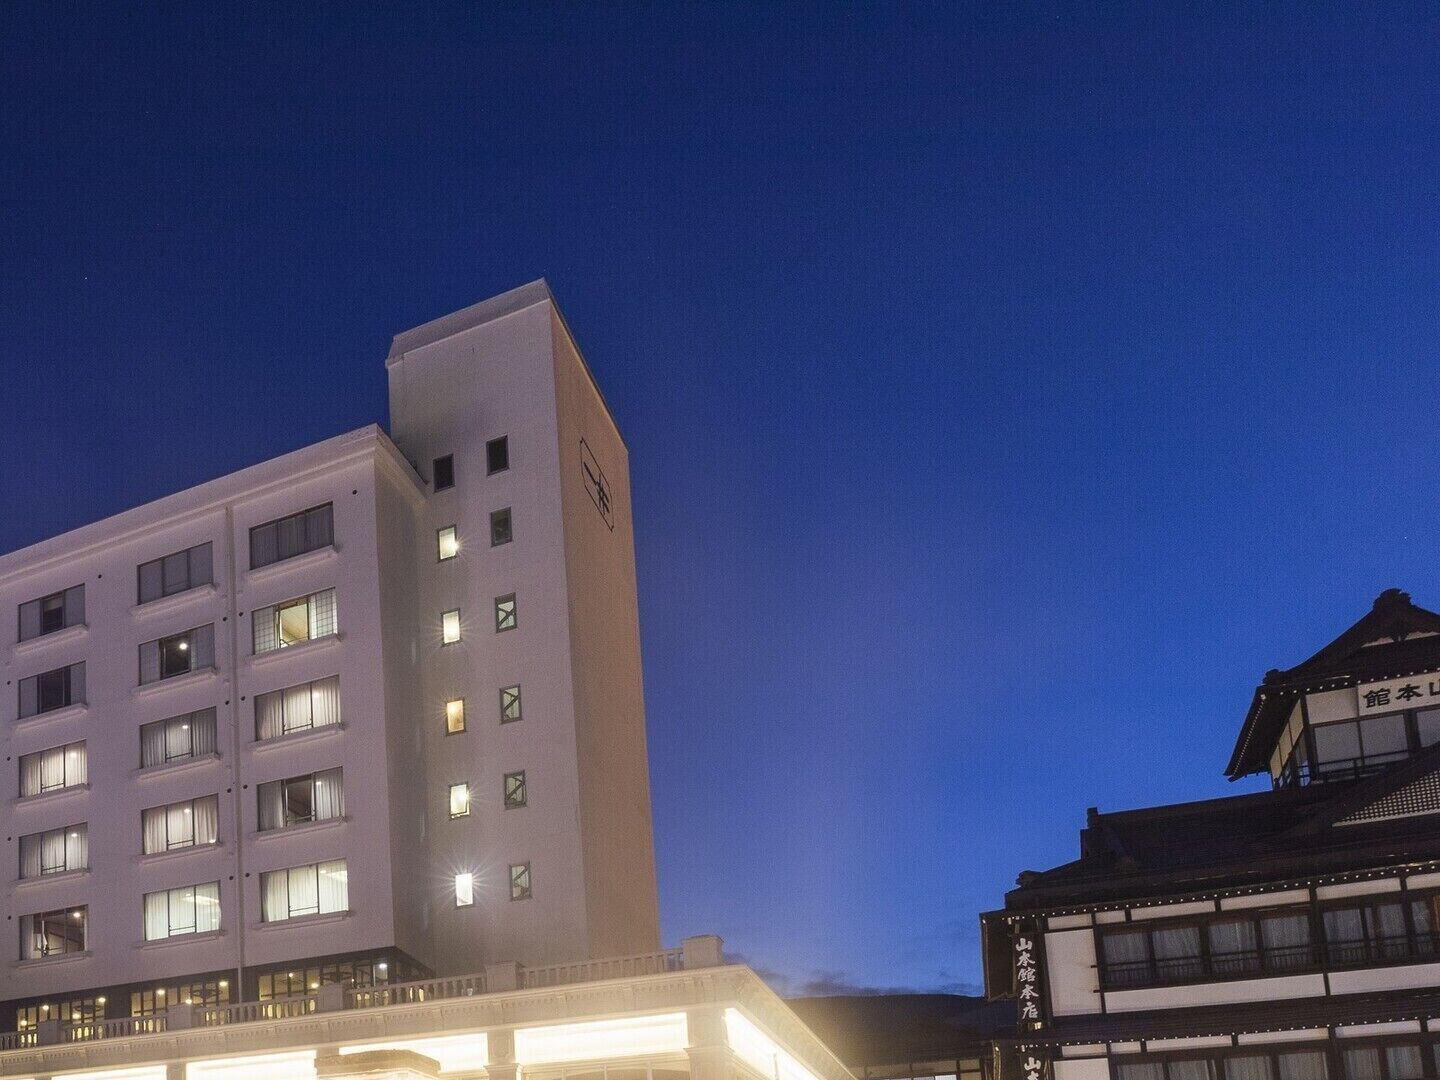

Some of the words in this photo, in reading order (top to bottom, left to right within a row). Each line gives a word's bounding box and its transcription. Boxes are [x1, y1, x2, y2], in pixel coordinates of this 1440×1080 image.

[1015, 937, 1039, 1020] 山本館本店
